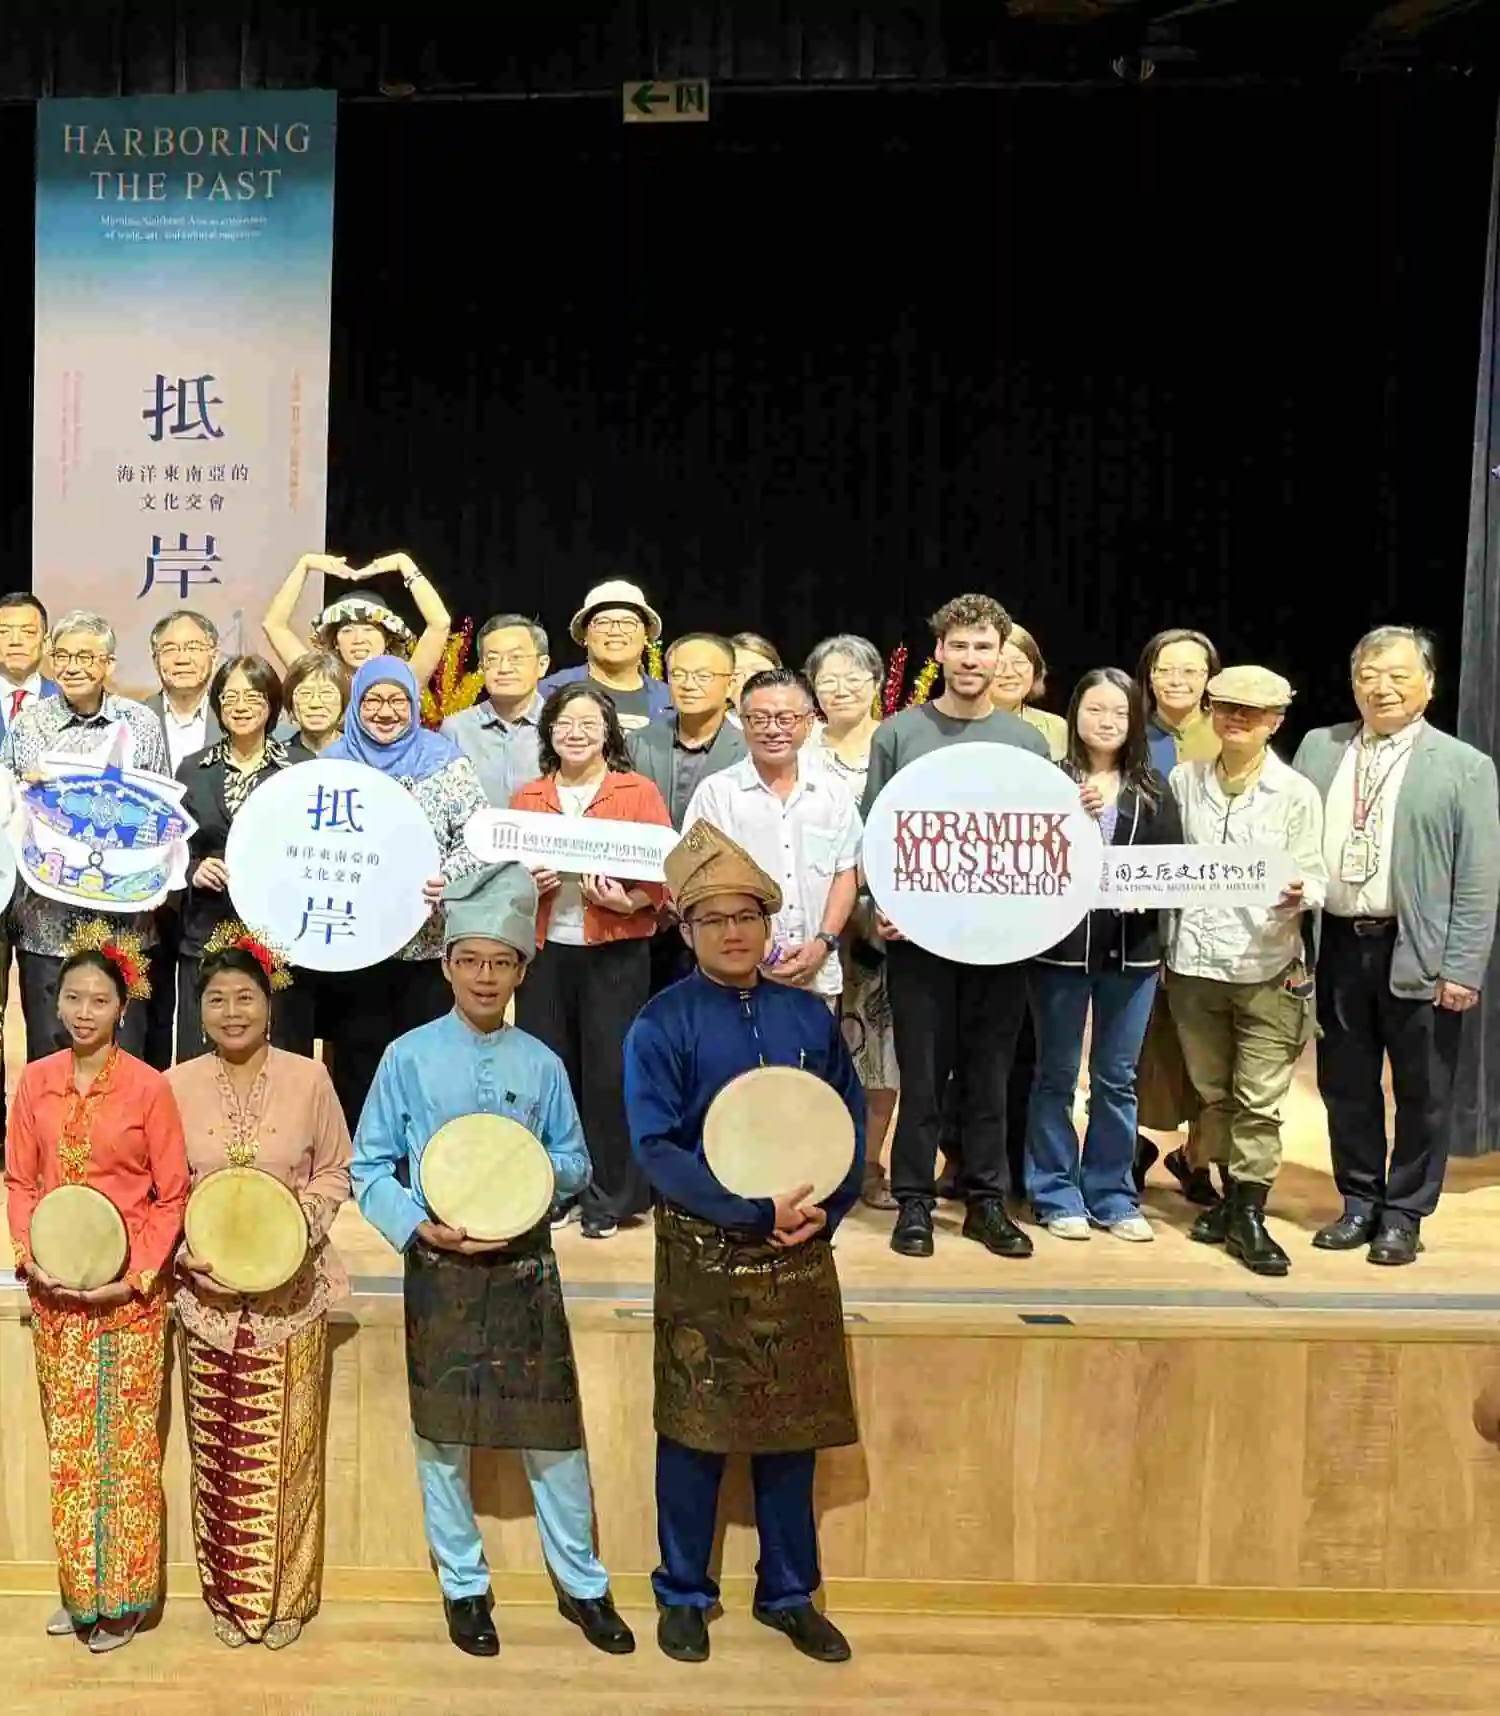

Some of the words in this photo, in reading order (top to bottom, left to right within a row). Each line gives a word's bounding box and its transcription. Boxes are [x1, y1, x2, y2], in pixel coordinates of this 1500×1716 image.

[63, 123, 311, 157] HARBORING
[90, 171, 168, 201] THE
[187, 168, 282, 201] PAST
[142, 373, 225, 442] 抵
[116, 463, 250, 483] 海洋東南亞的
[140, 493, 225, 512] 文化交會
[136, 532, 224, 600] 岸
[306, 784, 365, 834] 抵
[894, 810, 1071, 844] KERAMIEK
[894, 836, 1073, 882] MUSEUM
[894, 870, 1072, 897] PRINCESSEHOF
[294, 896, 357, 944] 岸
